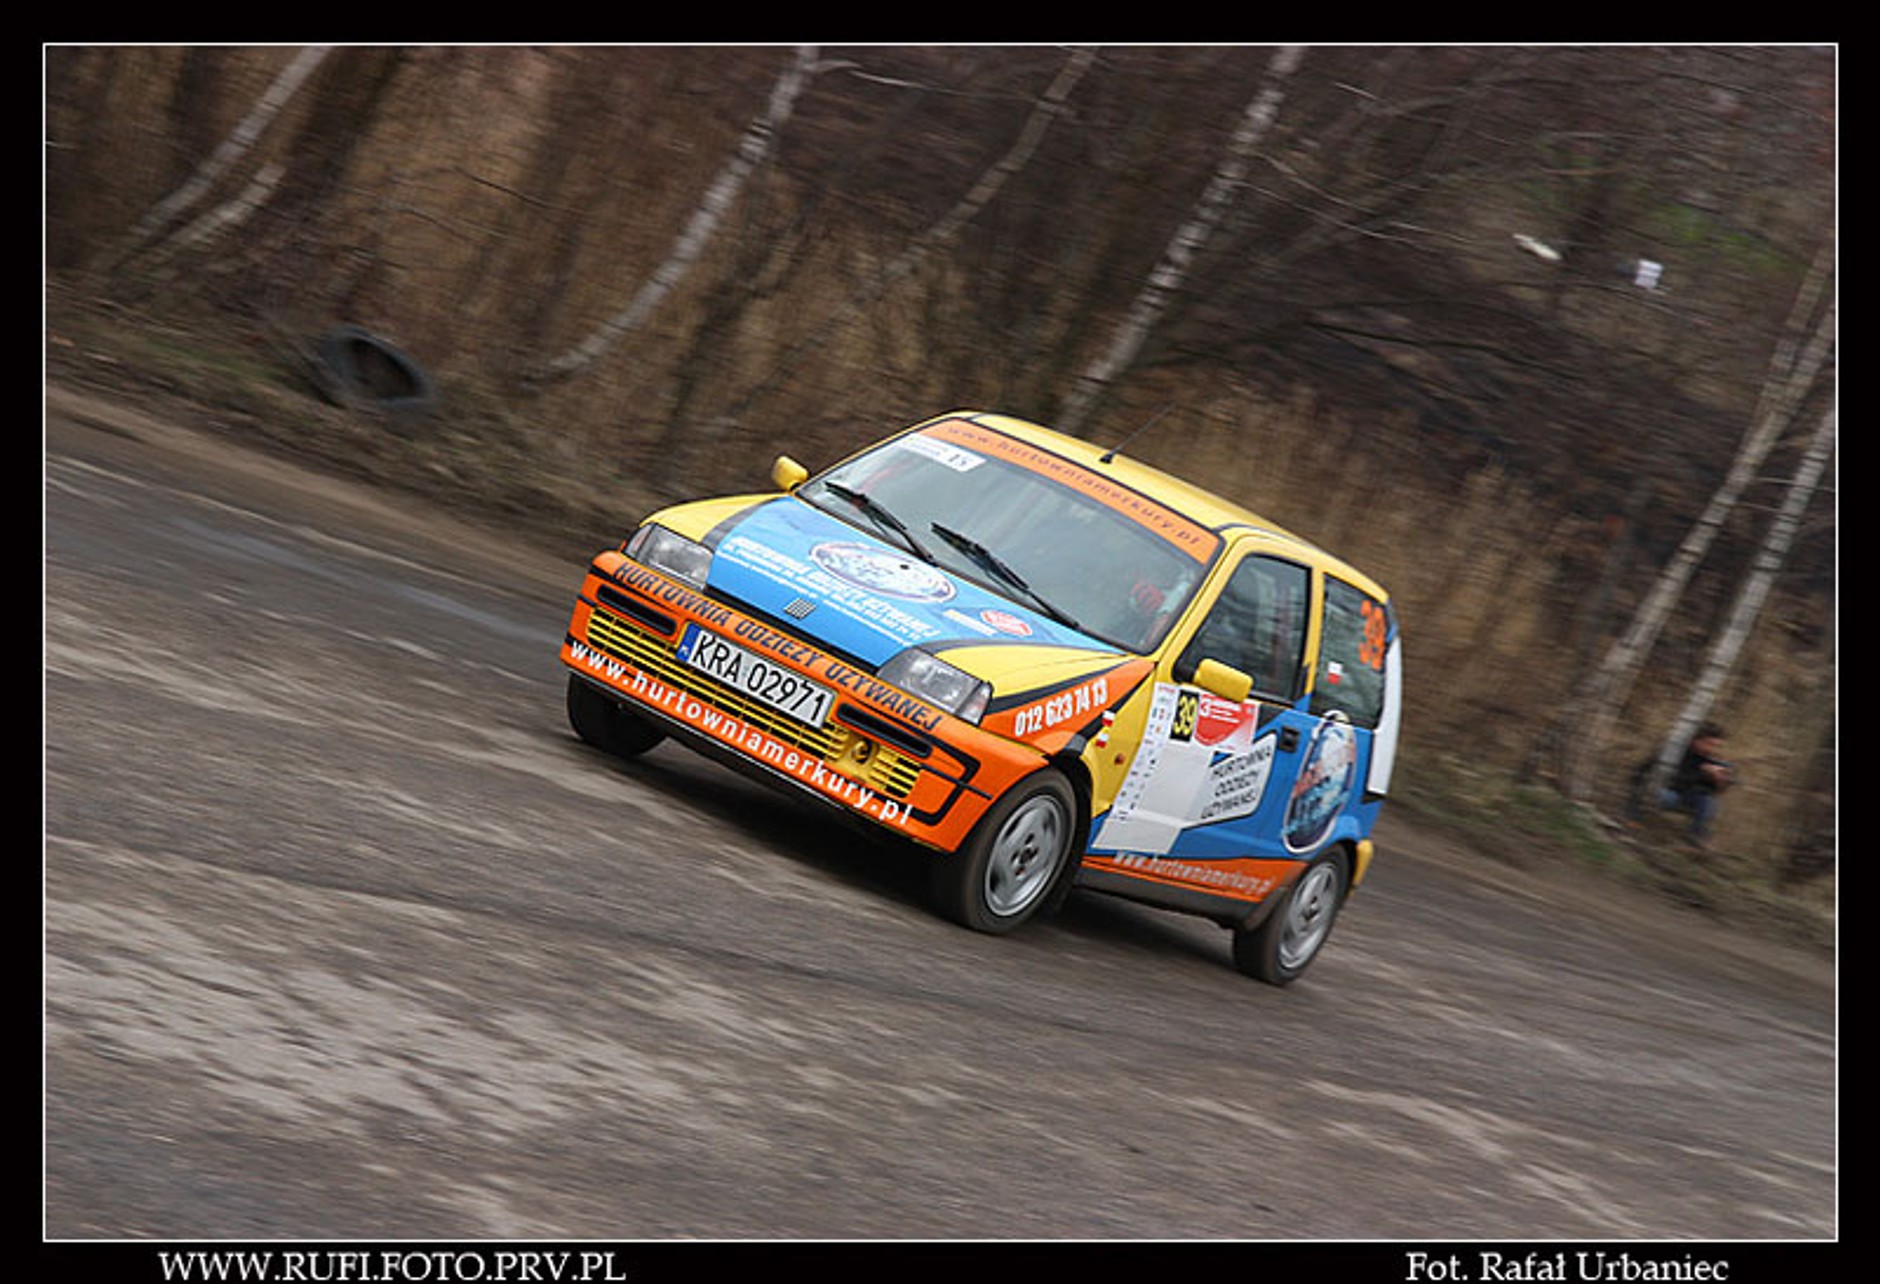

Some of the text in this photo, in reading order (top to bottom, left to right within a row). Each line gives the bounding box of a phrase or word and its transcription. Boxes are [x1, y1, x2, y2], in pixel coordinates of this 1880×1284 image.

[613, 561, 734, 627] HURTOWNIA
[691, 632, 828, 722] KRA 02971
[1014, 677, 1108, 737] 012 623 74 13
[568, 639, 914, 825] www.hurtowniamerkury.pl
[1172, 694, 1198, 736] 39
